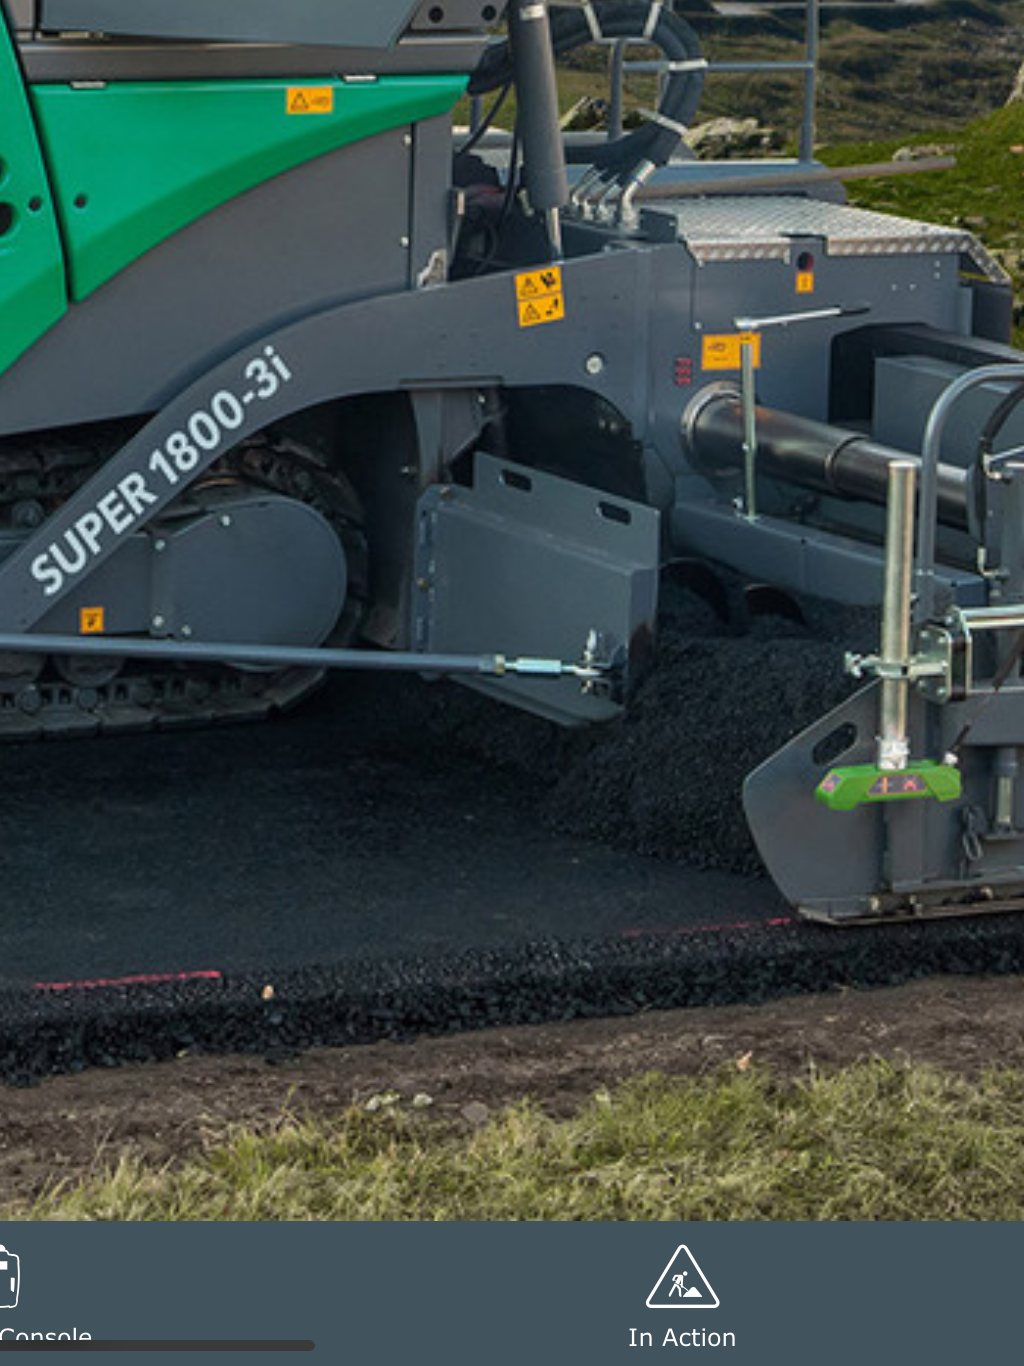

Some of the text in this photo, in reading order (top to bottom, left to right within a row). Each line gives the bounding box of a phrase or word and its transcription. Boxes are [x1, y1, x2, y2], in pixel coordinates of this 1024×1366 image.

[30, 345, 291, 595] SUPER 1800-3i
[628, 1327, 736, 1347] In Action
